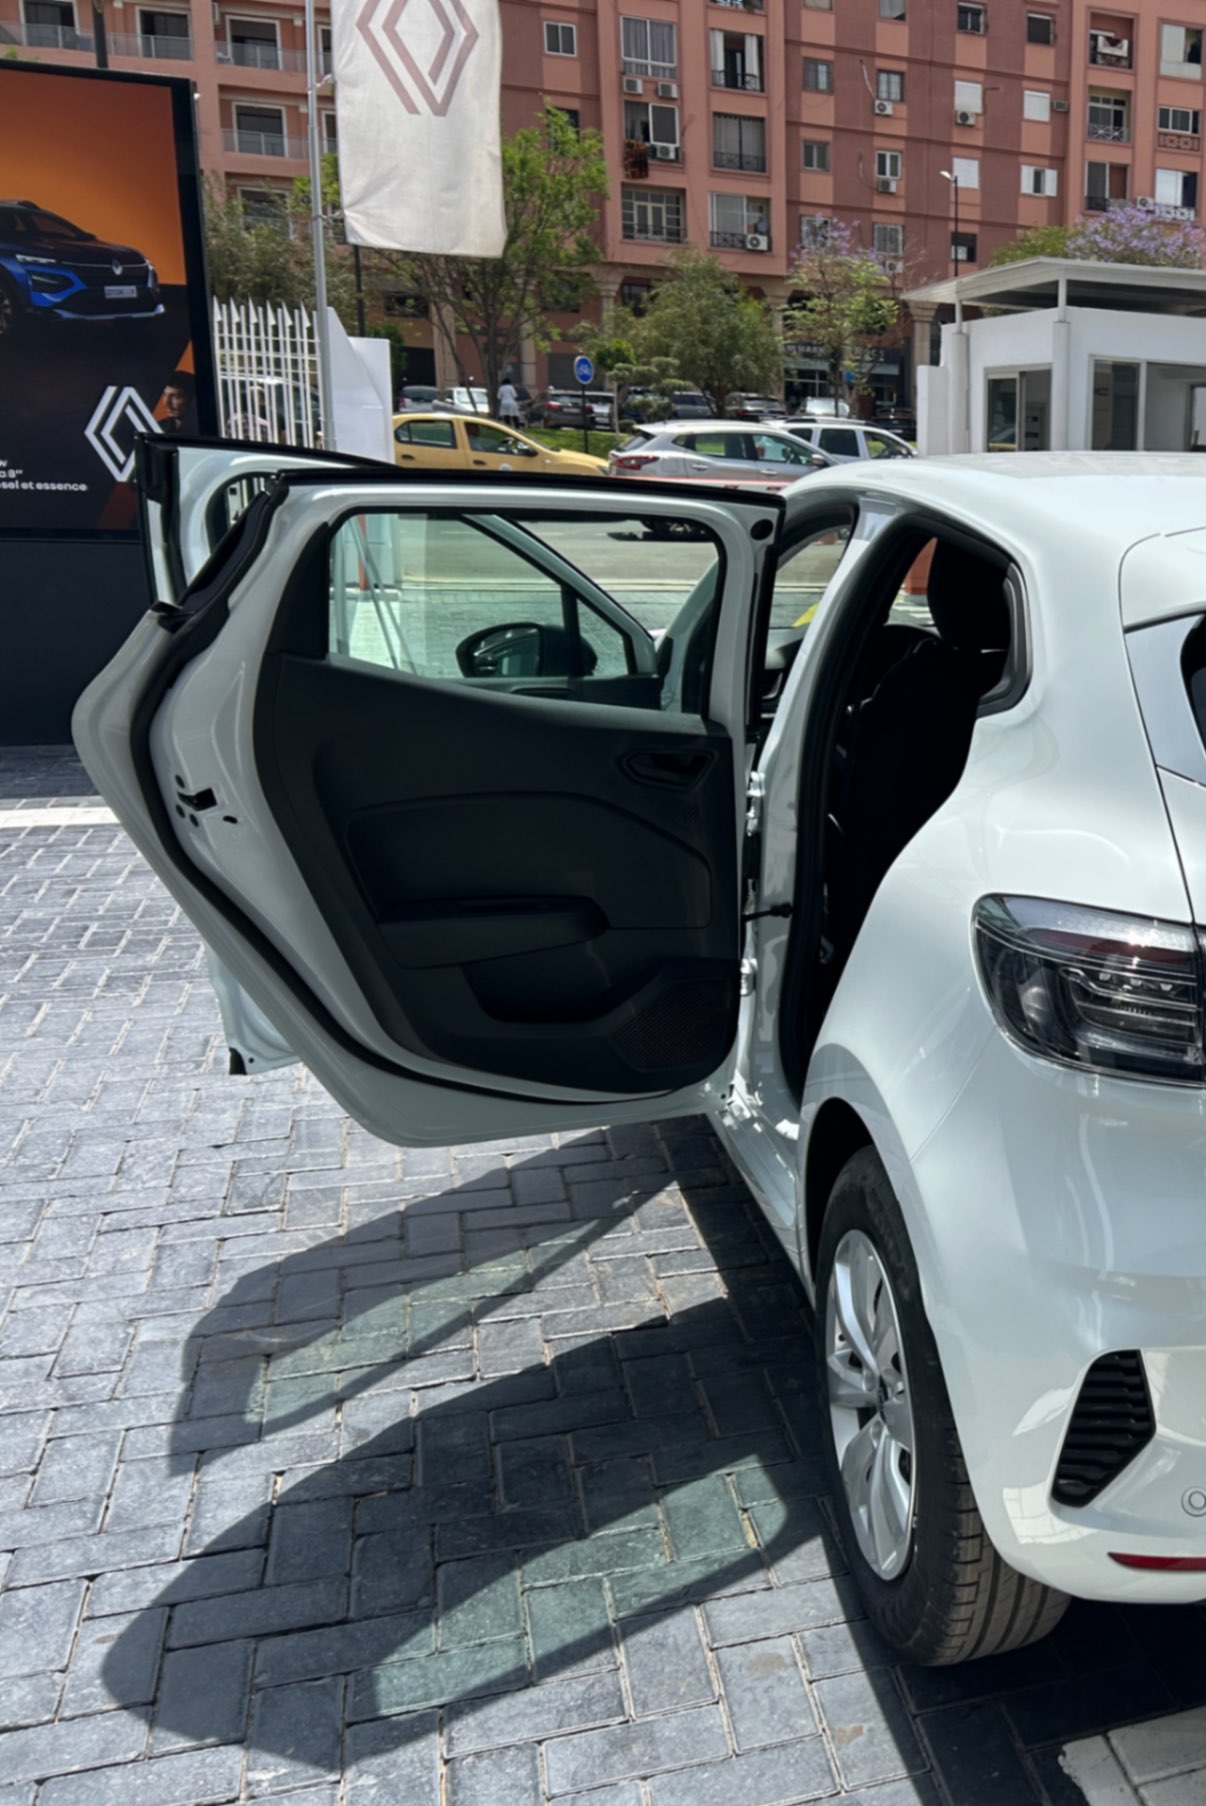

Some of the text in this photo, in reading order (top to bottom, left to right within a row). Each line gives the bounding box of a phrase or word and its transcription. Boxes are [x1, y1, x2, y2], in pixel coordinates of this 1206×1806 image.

[0, 480, 88, 491] sel et essence
